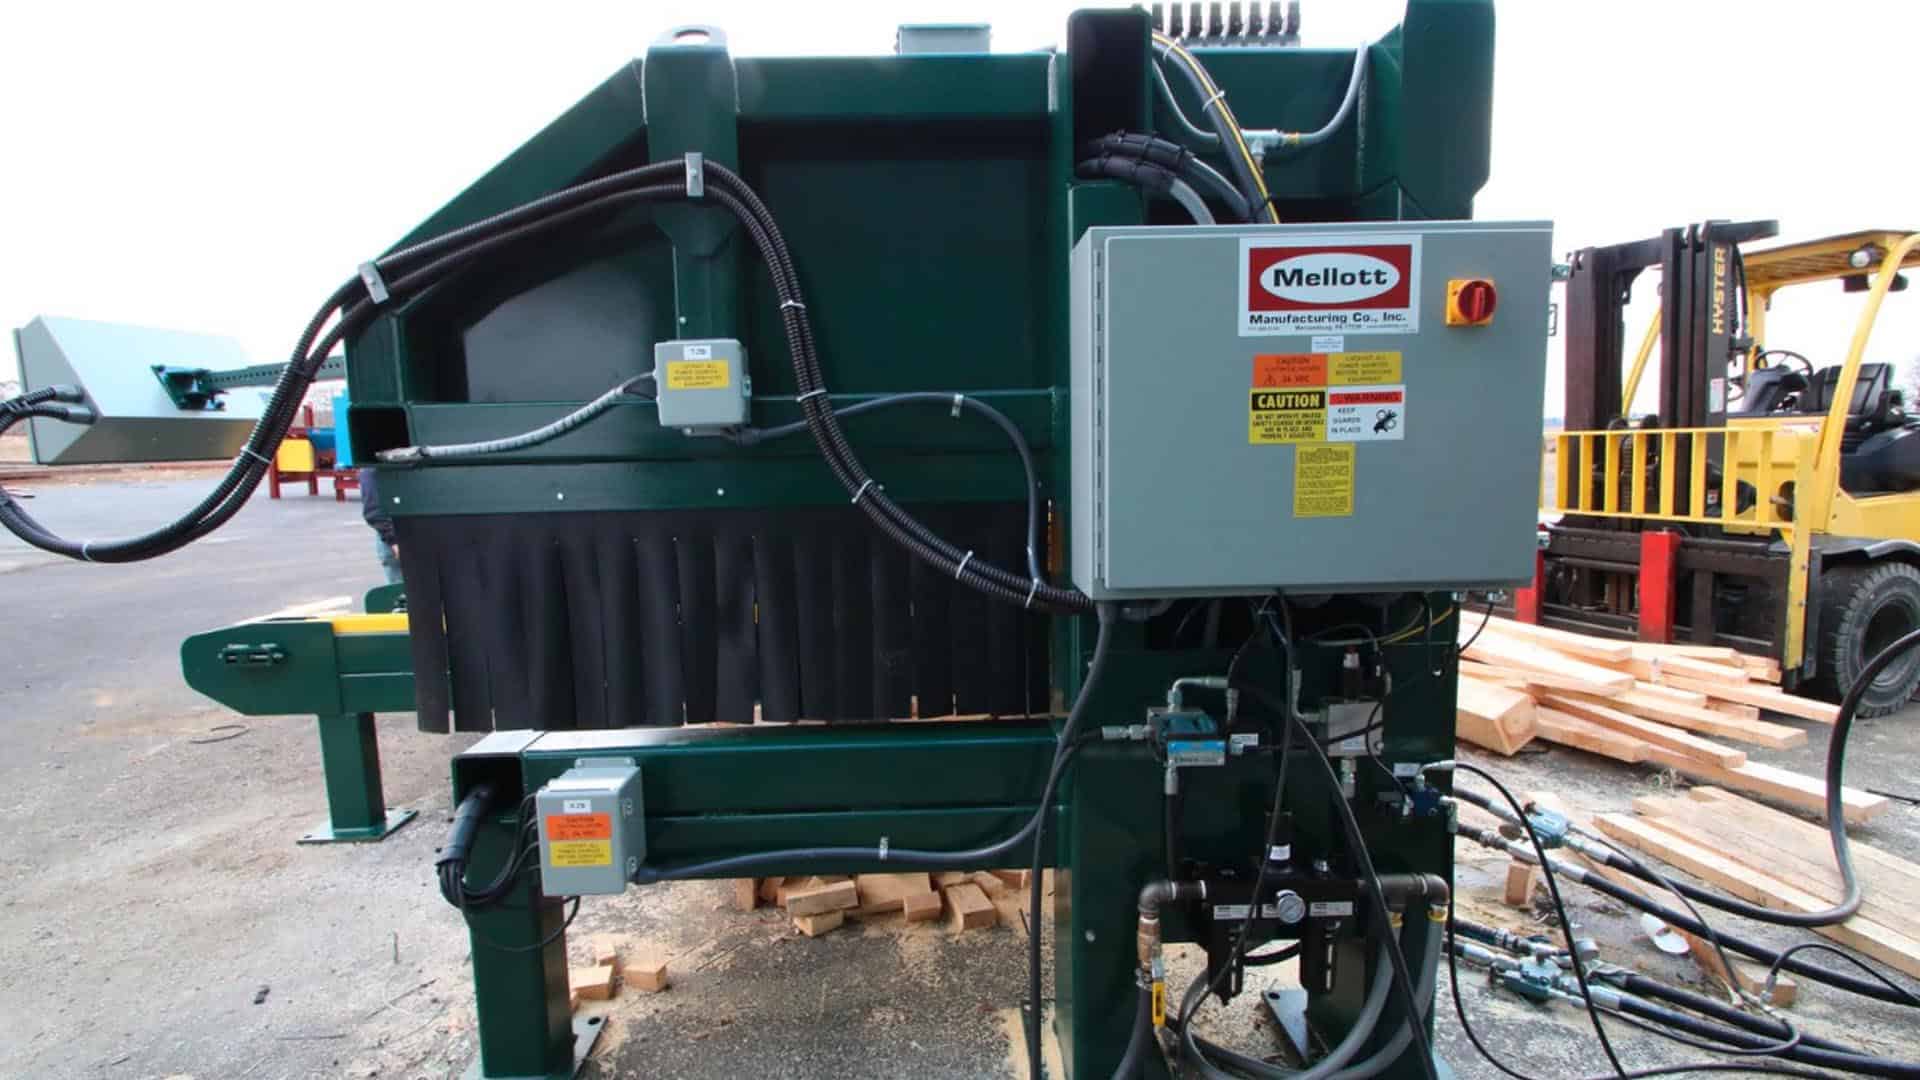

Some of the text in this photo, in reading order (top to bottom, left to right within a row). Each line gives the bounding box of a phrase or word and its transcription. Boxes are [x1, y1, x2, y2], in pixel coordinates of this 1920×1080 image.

[1273, 267, 1388, 287] Mellott
[1712, 247, 1726, 335] HYSTER
[1249, 311, 1406, 325] Manufacturing Co., Inc.
[1257, 394, 1320, 408] CAUTION
